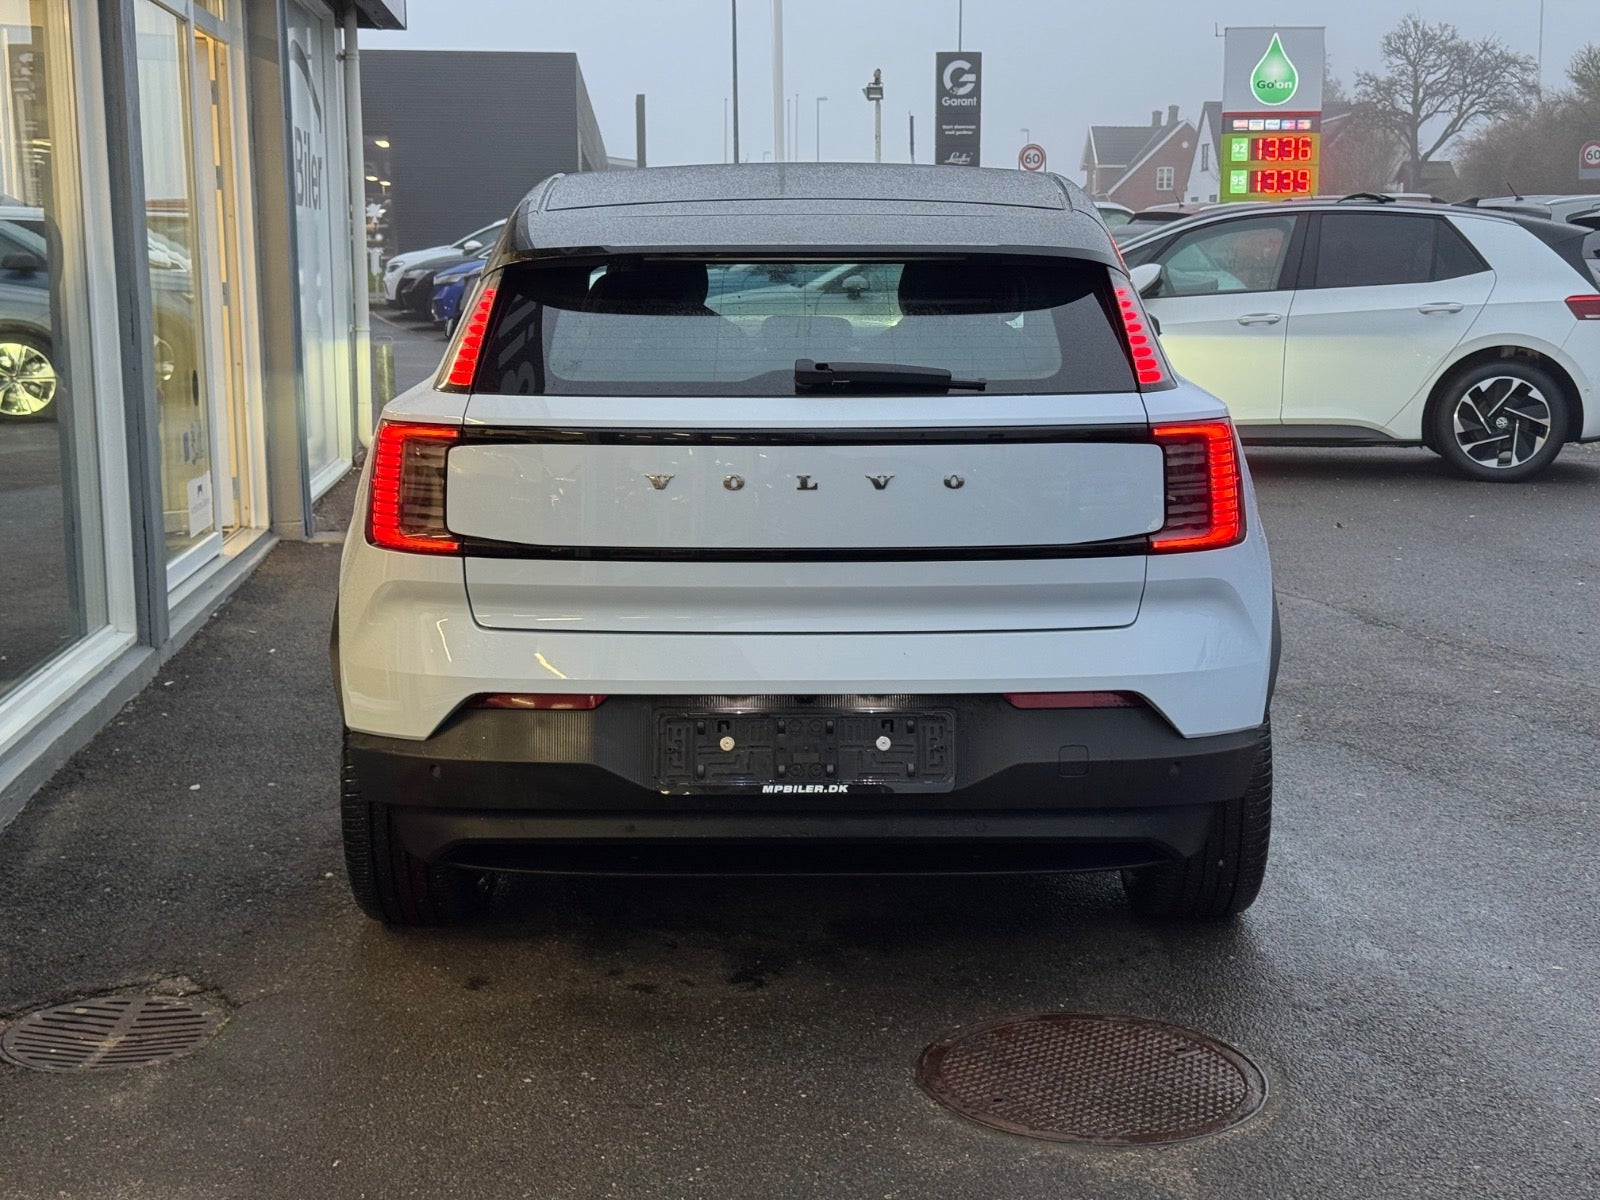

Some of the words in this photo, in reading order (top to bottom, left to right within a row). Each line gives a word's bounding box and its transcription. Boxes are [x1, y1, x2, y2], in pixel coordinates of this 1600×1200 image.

[1256, 80, 1292, 89] Go'on
[942, 96, 977, 106] Garant
[1233, 143, 1246, 153] 92
[1258, 137, 1312, 161] 13.36
[1586, 149, 1600, 161] 60
[1024, 153, 1040, 164] 60
[294, 126, 323, 210] Biler
[1232, 175, 1245, 185] 95
[1257, 169, 1310, 193] 13.39
[644, 473, 966, 490] VOLVO
[762, 784, 849, 793] MPBILER.DK
